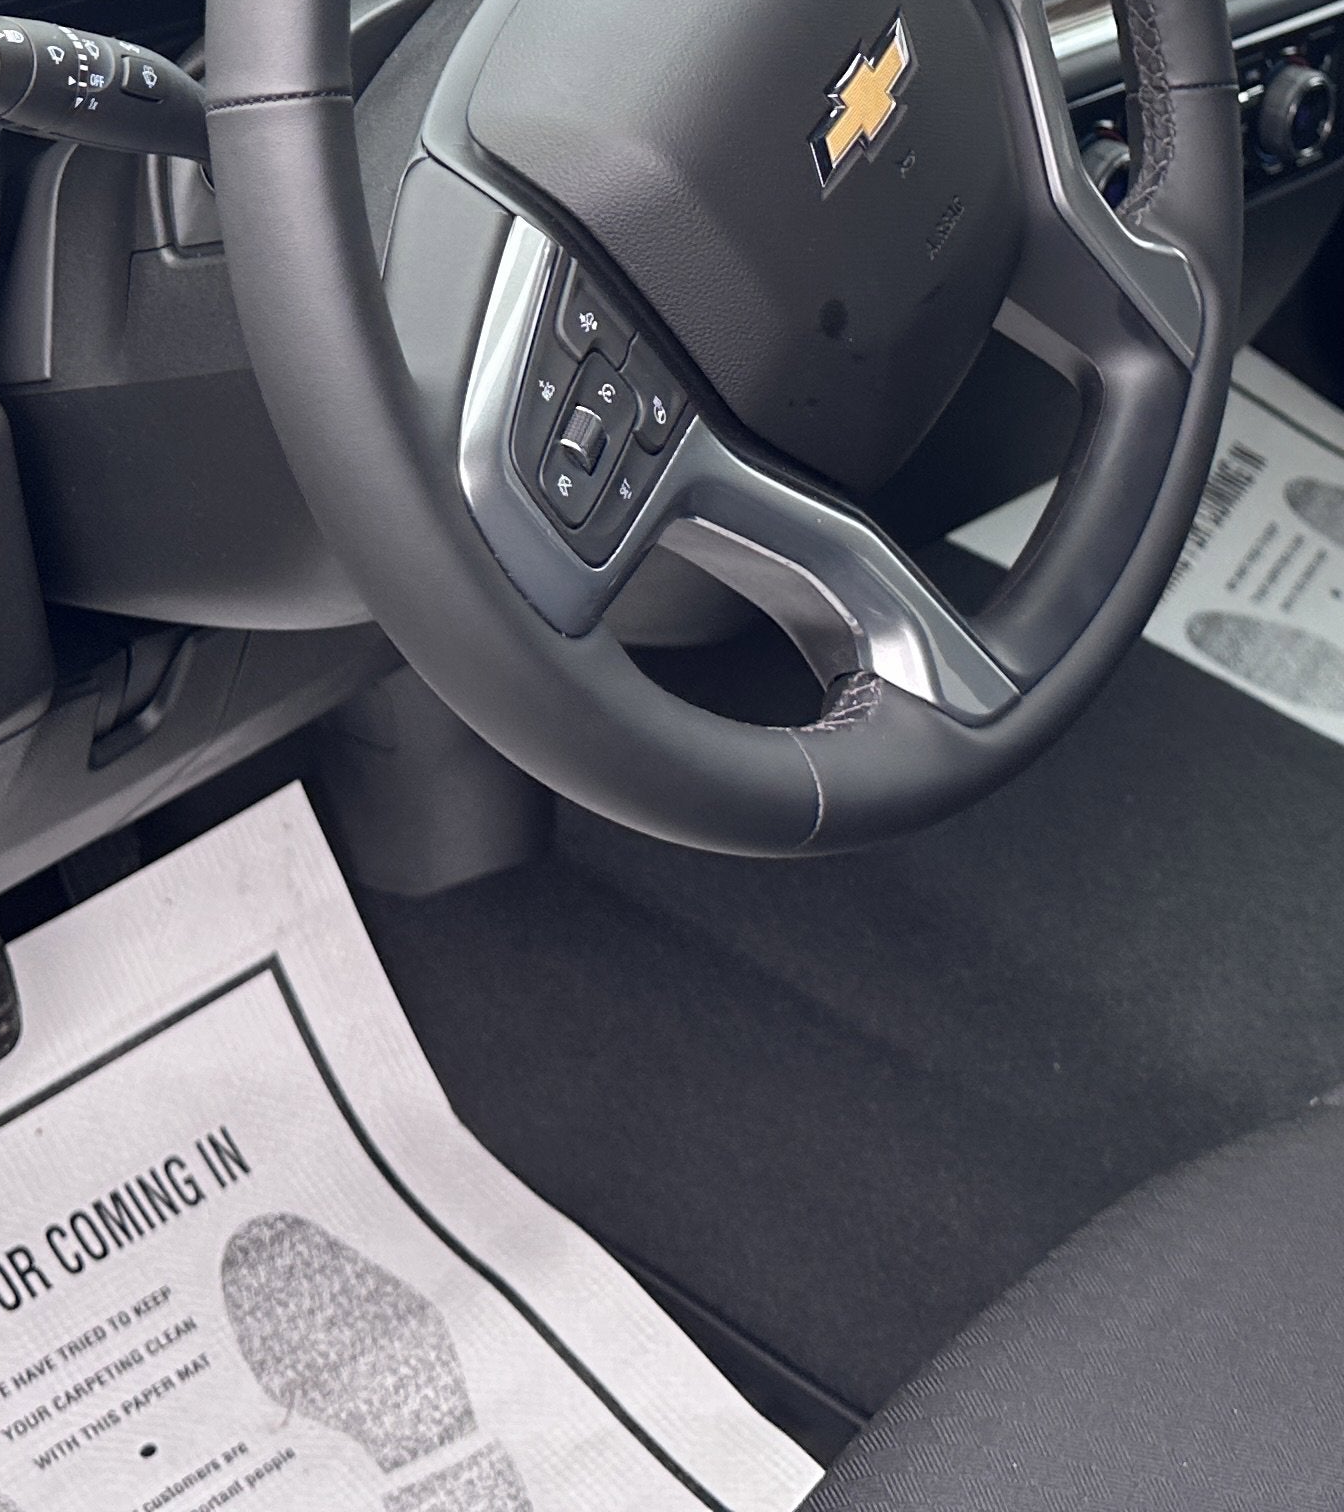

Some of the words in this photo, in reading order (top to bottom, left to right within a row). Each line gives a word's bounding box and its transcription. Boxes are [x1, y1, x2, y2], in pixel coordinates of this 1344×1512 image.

[90, 73, 105, 88] OFF
[44, 1154, 208, 1276] COMING
[195, 1125, 252, 1189] IN
[0, 1404, 53, 1442] YOUR
[52, 1348, 144, 1412] CARPETING
[143, 1315, 199, 1357] CLEAN
[11, 1354, 57, 1391] HAVE
[56, 1324, 107, 1362] TRIED
[106, 1309, 132, 1333] TO
[132, 1285, 172, 1319] KEEP
[32, 1434, 81, 1471] WITH
[79, 1408, 122, 1442] THIS
[120, 1375, 177, 1417] PAPER
[175, 1351, 212, 1383] MAT
[142, 1458, 222, 1512] customers
[221, 1440, 249, 1464] are
[244, 1446, 296, 1489] people
